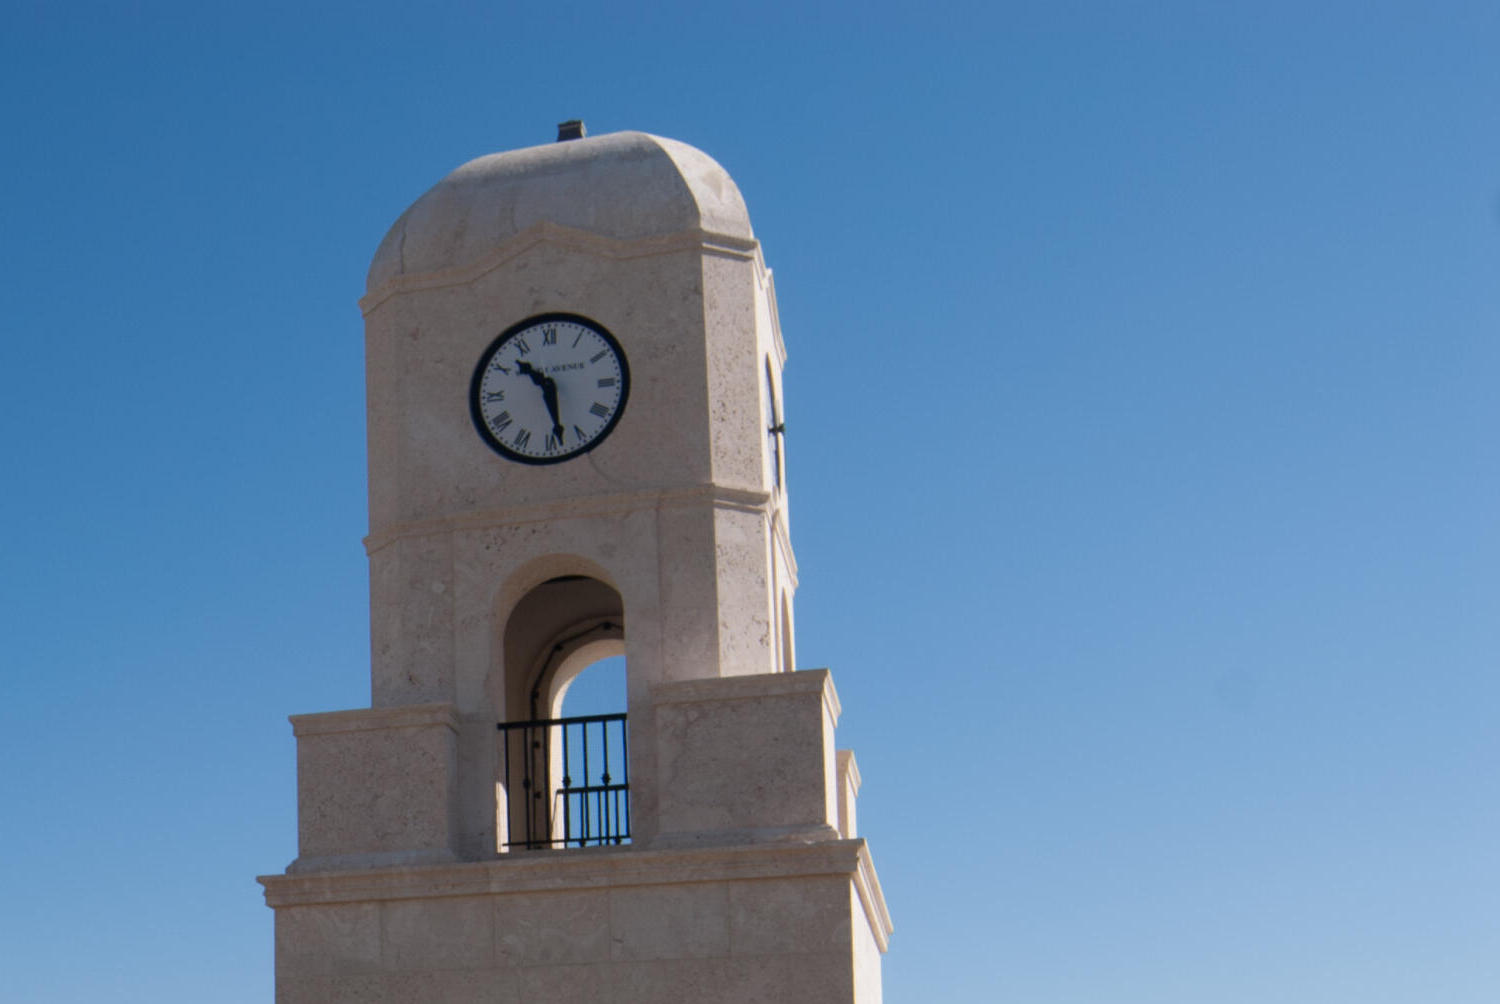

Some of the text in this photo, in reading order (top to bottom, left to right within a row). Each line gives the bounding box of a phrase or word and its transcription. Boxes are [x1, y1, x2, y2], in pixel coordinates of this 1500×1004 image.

[543, 328, 557, 347] XII
[514, 339, 530, 357] XI
[589, 349, 610, 364] II
[494, 363, 511, 375] X
[551, 362, 585, 373] AVENUE
[597, 377, 615, 388] III
[486, 390, 504, 403] IX
[574, 424, 586, 440] V
[545, 433, 557, 451] VI
